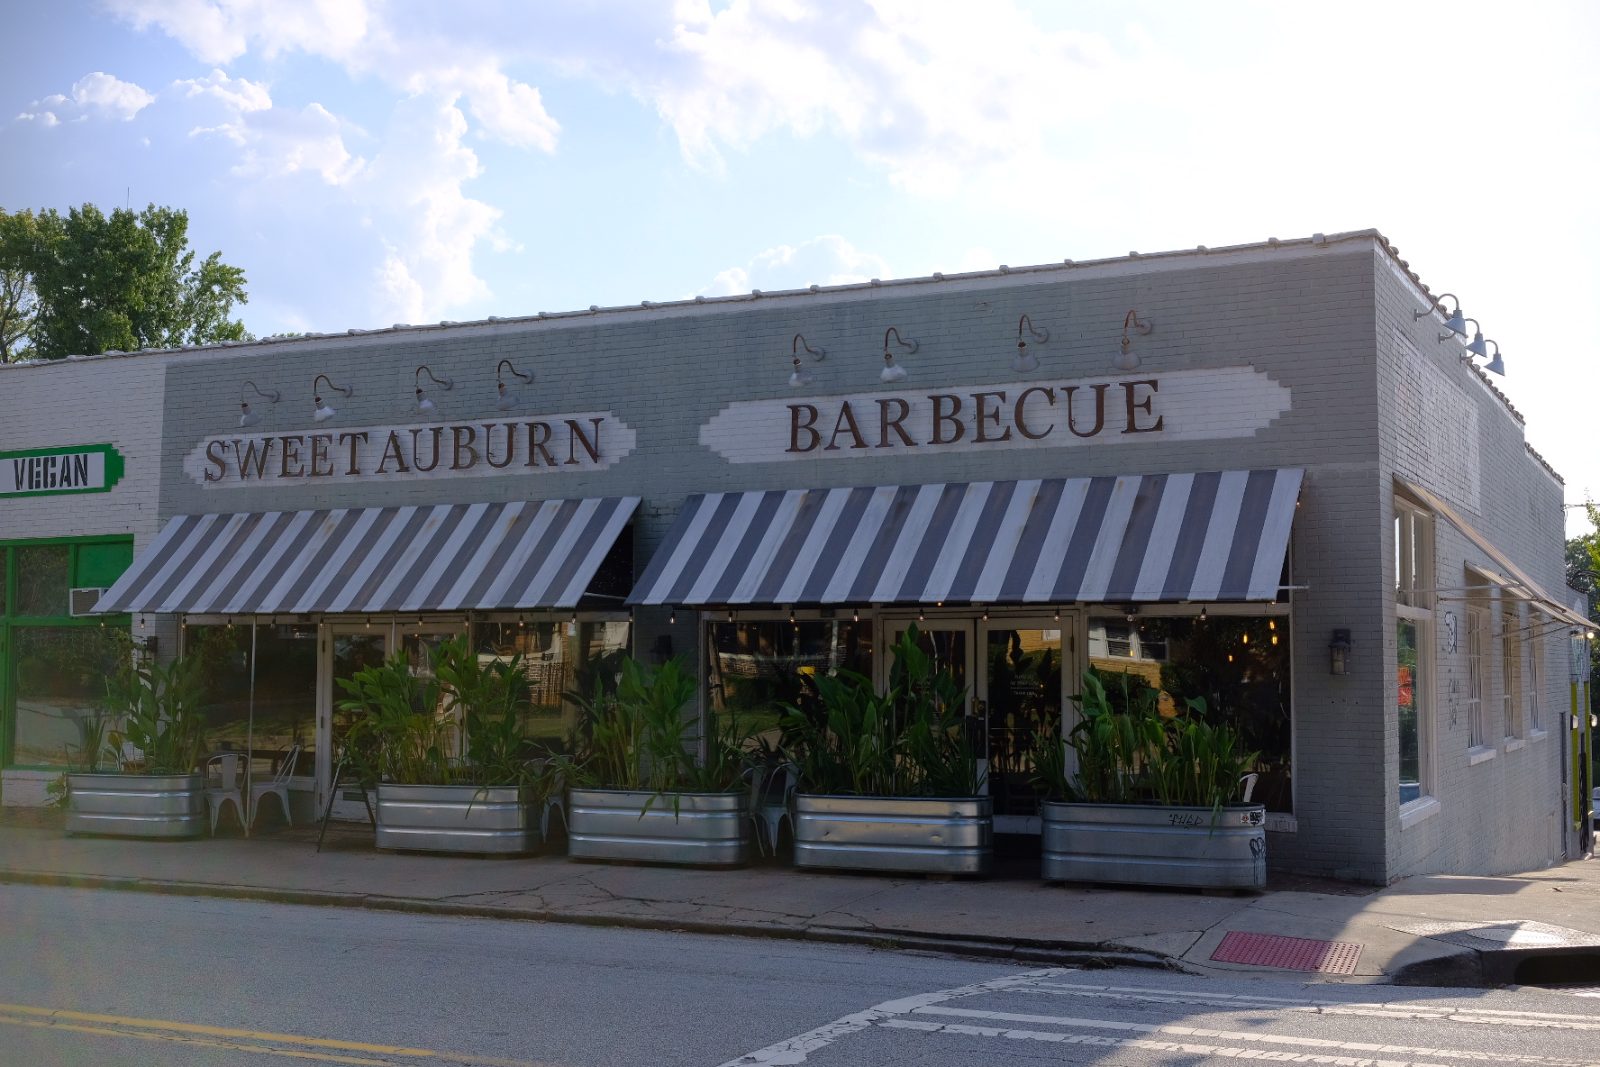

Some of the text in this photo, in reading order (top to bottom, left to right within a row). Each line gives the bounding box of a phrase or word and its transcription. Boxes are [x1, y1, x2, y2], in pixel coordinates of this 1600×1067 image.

[785, 378, 1164, 453] BARBECUE
[14, 454, 88, 490] VEGAN
[204, 417, 605, 481] SWEET AUBURN
